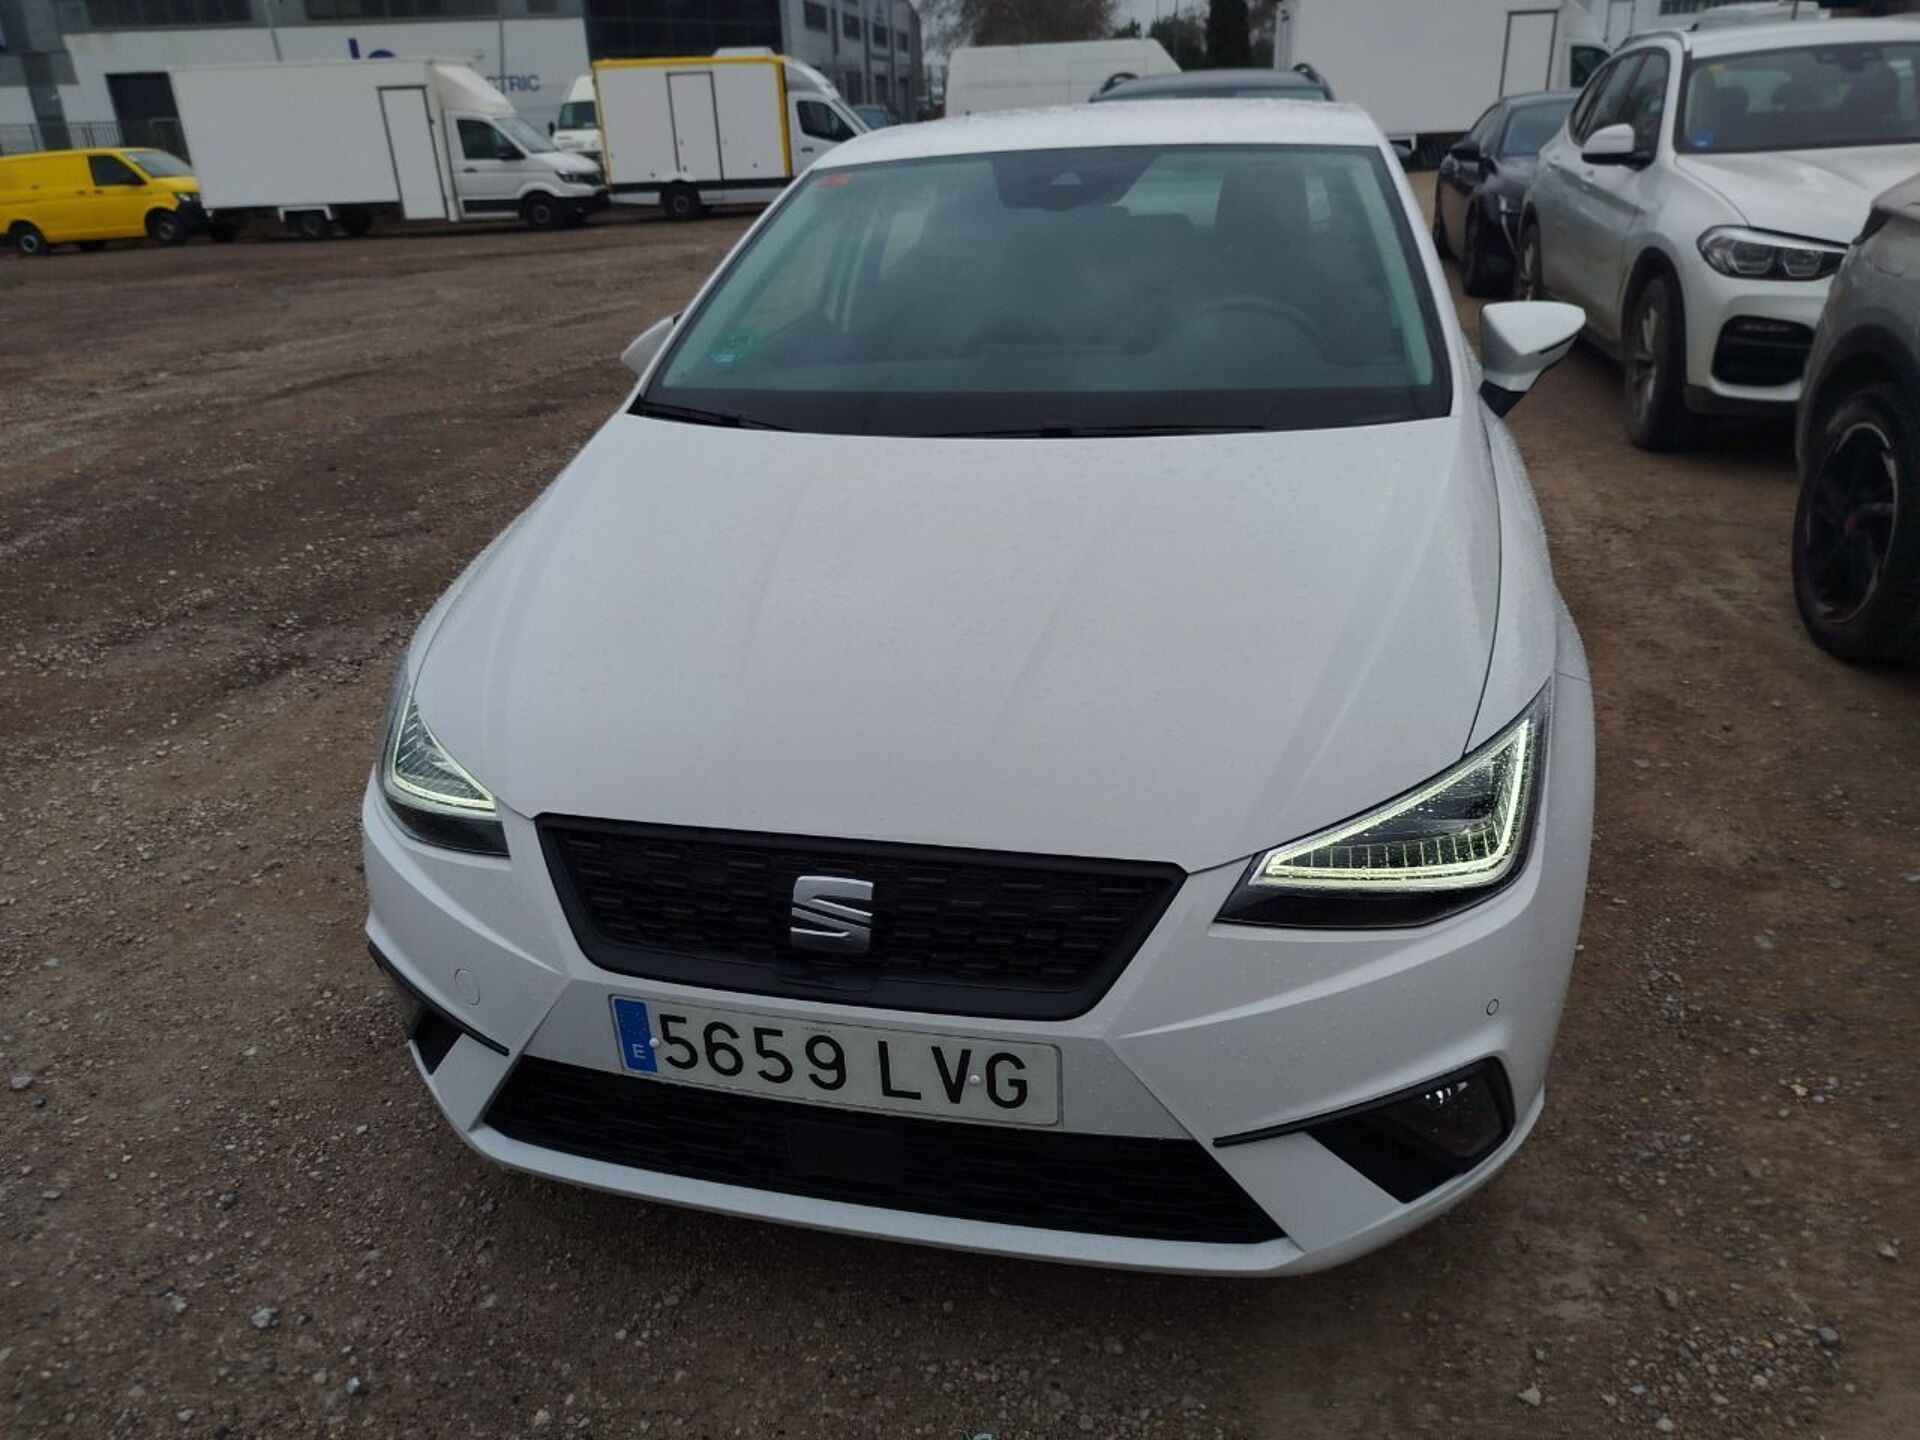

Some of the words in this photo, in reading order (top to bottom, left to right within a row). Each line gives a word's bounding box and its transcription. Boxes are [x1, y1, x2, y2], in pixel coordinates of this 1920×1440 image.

[631, 1043, 648, 1060] E
[658, 1013, 848, 1091] 5659
[877, 1039, 1029, 1109] LVG
